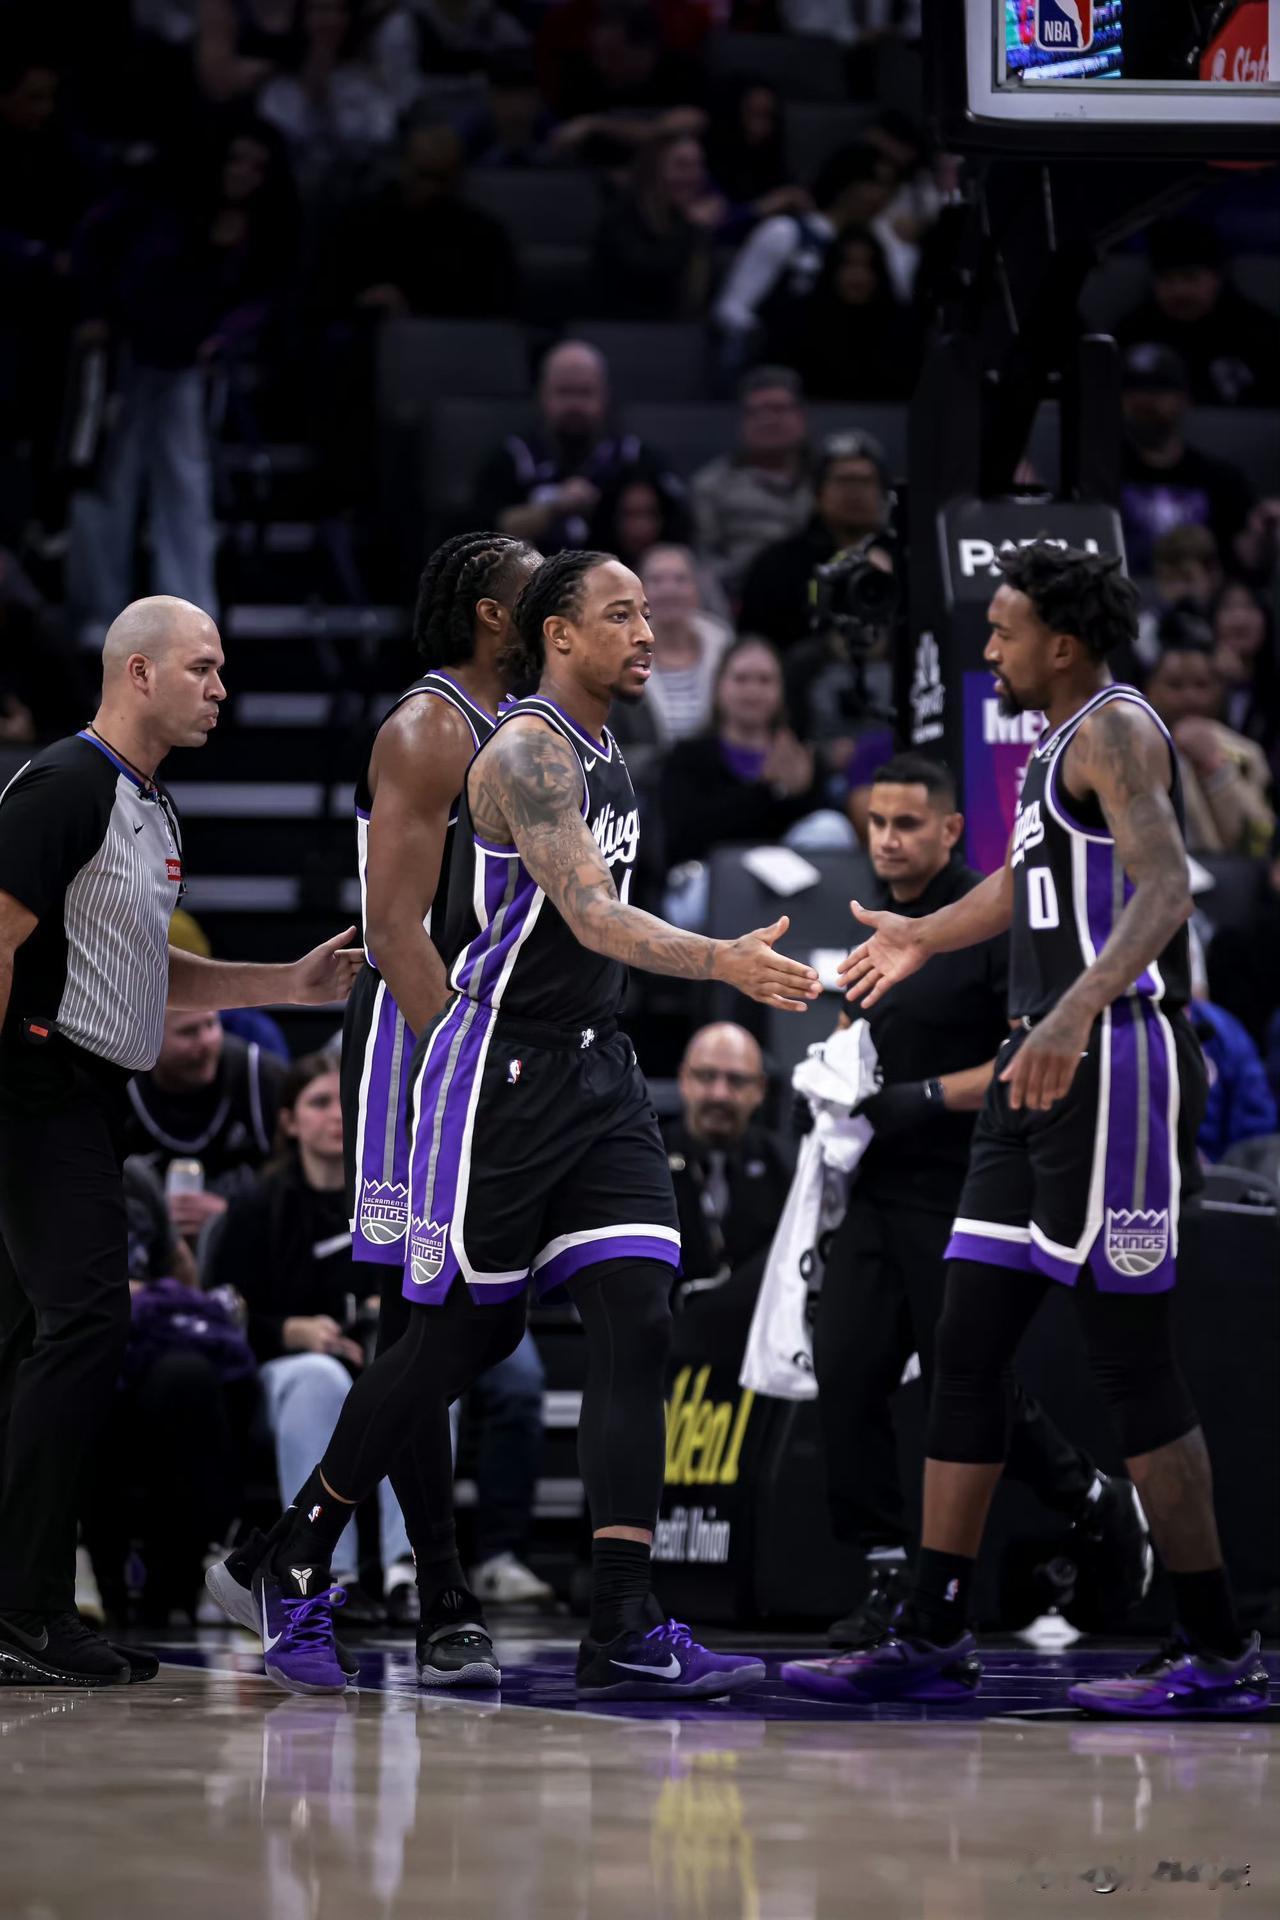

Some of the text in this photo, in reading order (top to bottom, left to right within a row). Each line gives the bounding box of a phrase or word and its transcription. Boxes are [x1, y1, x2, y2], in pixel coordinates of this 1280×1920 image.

[1044, 20, 1072, 42] NBA
[1027, 866, 1060, 930] 0
[362, 1205, 407, 1223] KINGS
[1109, 1236, 1164, 1249] KINGS
